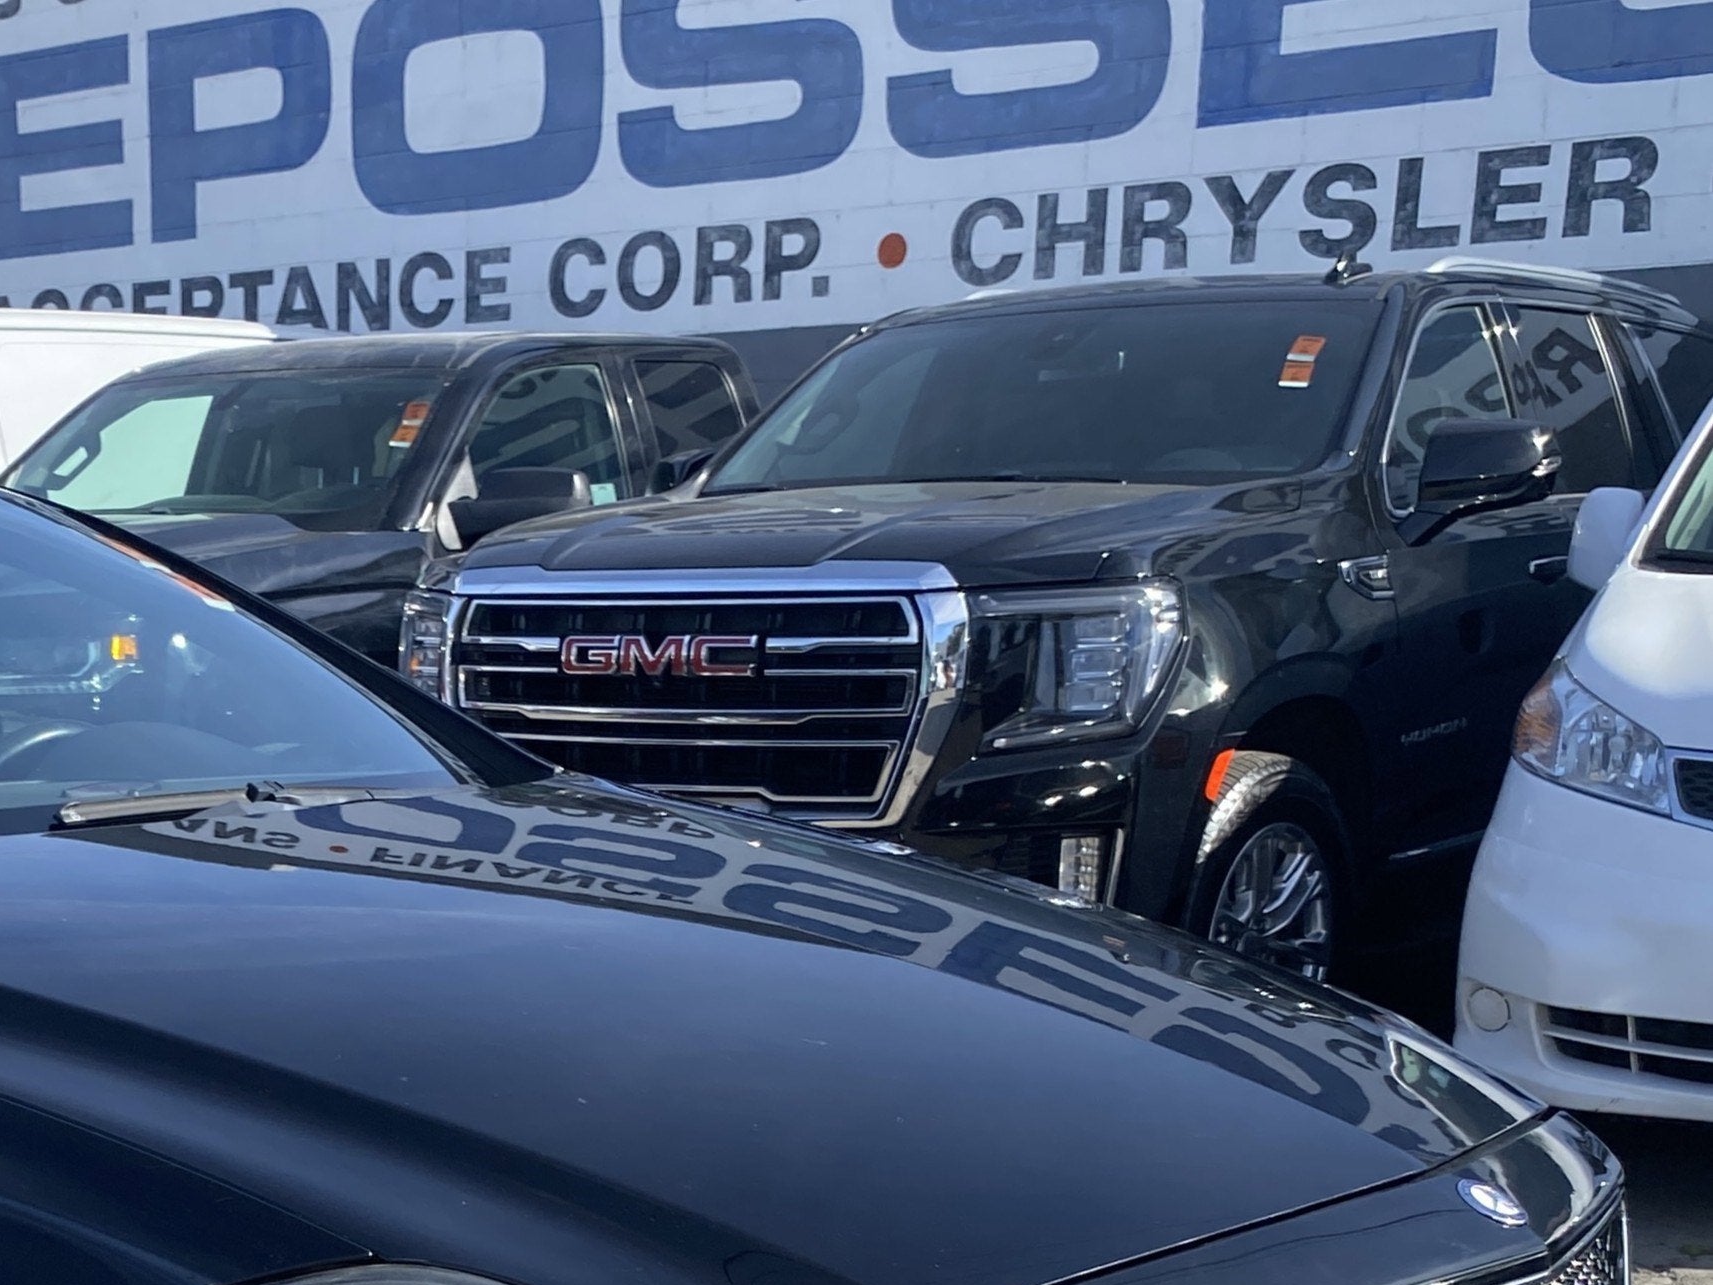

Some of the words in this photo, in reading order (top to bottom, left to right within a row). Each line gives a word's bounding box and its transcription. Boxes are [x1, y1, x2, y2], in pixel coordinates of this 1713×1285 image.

[547, 217, 830, 318] CORP.
[950, 136, 1661, 286] CHRYSLER
[561, 634, 757, 677] GMC
